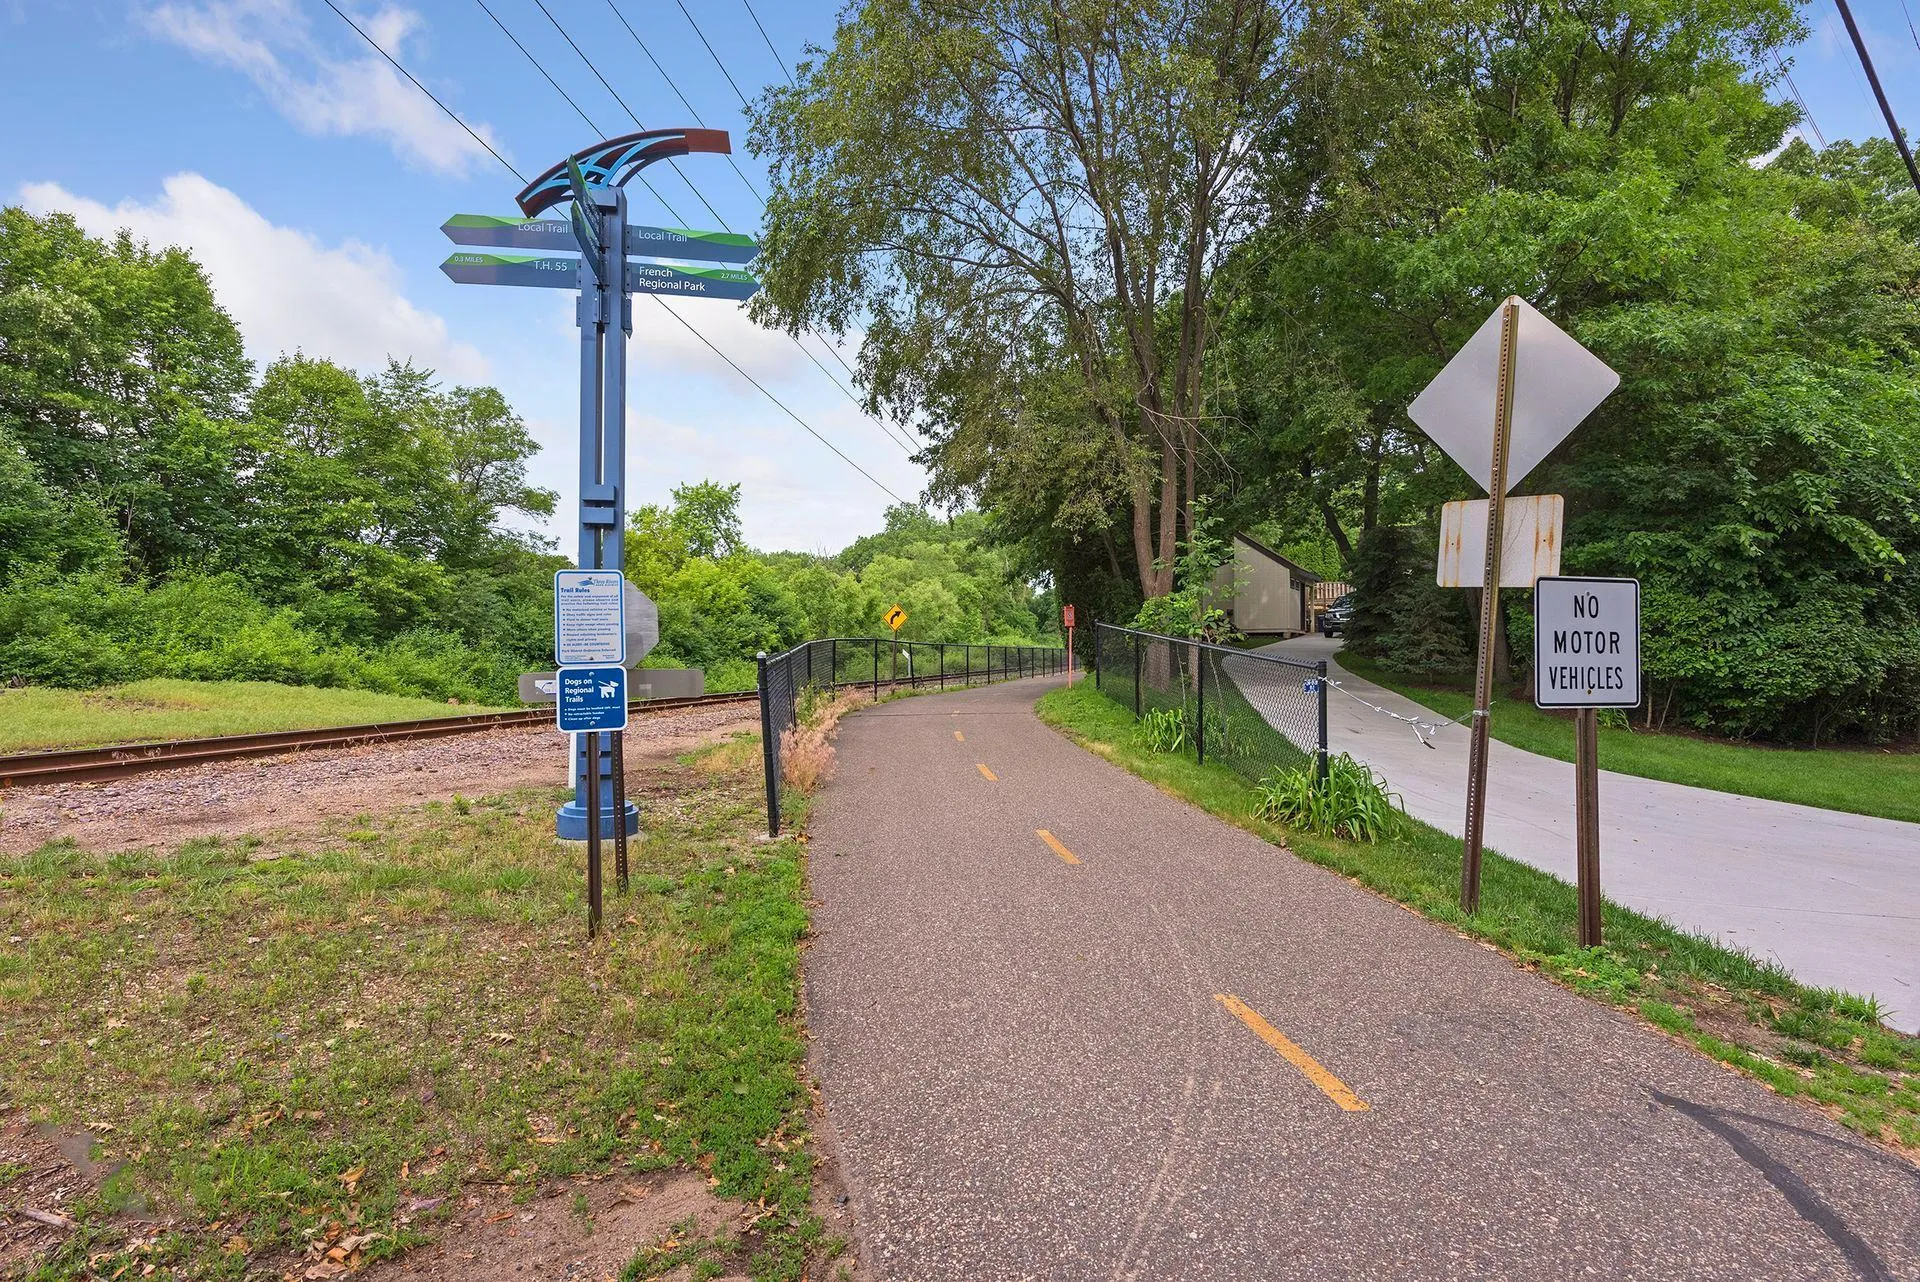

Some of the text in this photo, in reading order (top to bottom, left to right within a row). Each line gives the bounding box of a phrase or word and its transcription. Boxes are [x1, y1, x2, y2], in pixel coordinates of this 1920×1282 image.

[518, 223, 568, 234] Local Trail
[638, 230, 687, 242] Local Trail
[534, 260, 568, 272] T.H. 55
[640, 266, 673, 277] French
[639, 278, 706, 292] Regional Park
[1574, 595, 1599, 618] NO
[1554, 630, 1620, 654] MOTOR
[1549, 666, 1623, 690] VEHICLES
[565, 686, 594, 695] Regional
